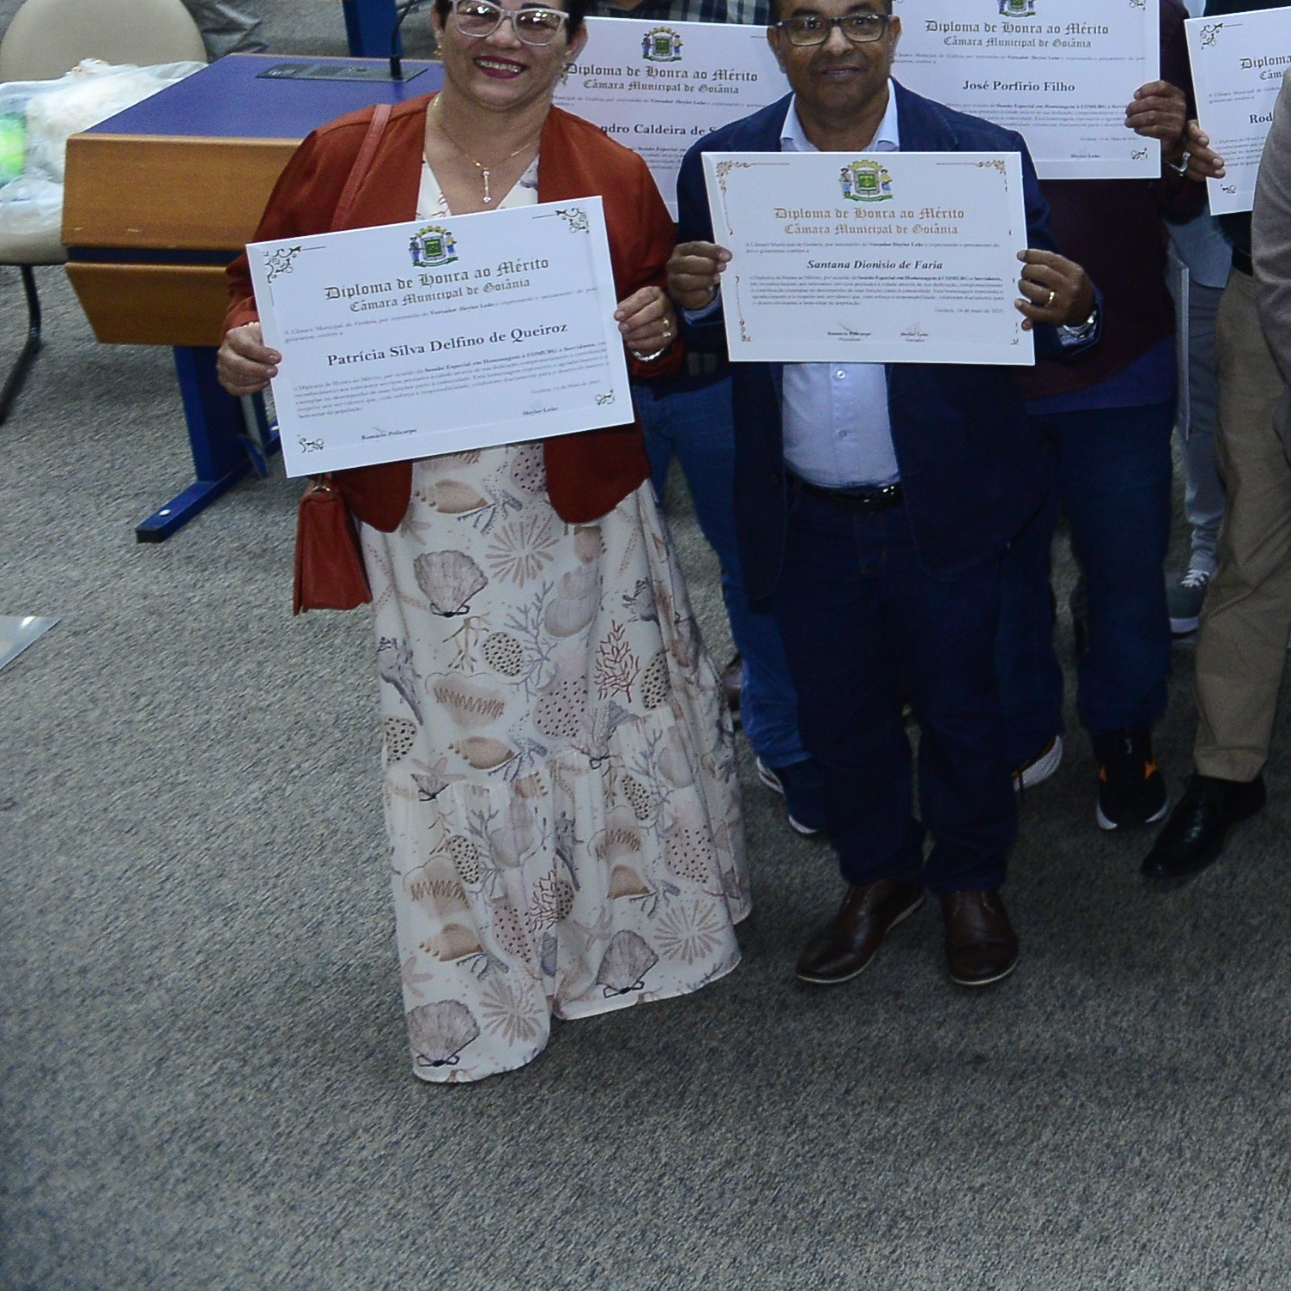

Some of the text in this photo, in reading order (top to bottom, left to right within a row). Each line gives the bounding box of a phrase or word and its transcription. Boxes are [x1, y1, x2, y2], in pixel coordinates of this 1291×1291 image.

[925, 20, 1109, 35] Diploma de Honra ao Mérito
[944, 36, 1091, 49] Câmara Municipal de Goiânia
[627, 65, 640, 76] de
[646, 65, 688, 79] Honra
[693, 70, 707, 79] ao
[711, 68, 758, 81] Mérito
[963, 80, 989, 91] José
[1044, 81, 1075, 91] Filho
[634, 124, 705, 135] Caldeira de
[774, 207, 831, 221] Diploma
[835, 208, 848, 218] de
[900, 210, 914, 218] ao
[835, 223, 891, 235] Municipal
[897, 224, 908, 233] de
[807, 260, 850, 269] Santana
[899, 260, 911, 269] de
[915, 260, 943, 269] Faria
[324, 257, 549, 300] Diploma de Honra ao Mérito
[350, 278, 530, 313] Câmara Municipal de Goiânia
[327, 322, 568, 366] Patrícia Silva Delfino de Queiroz
